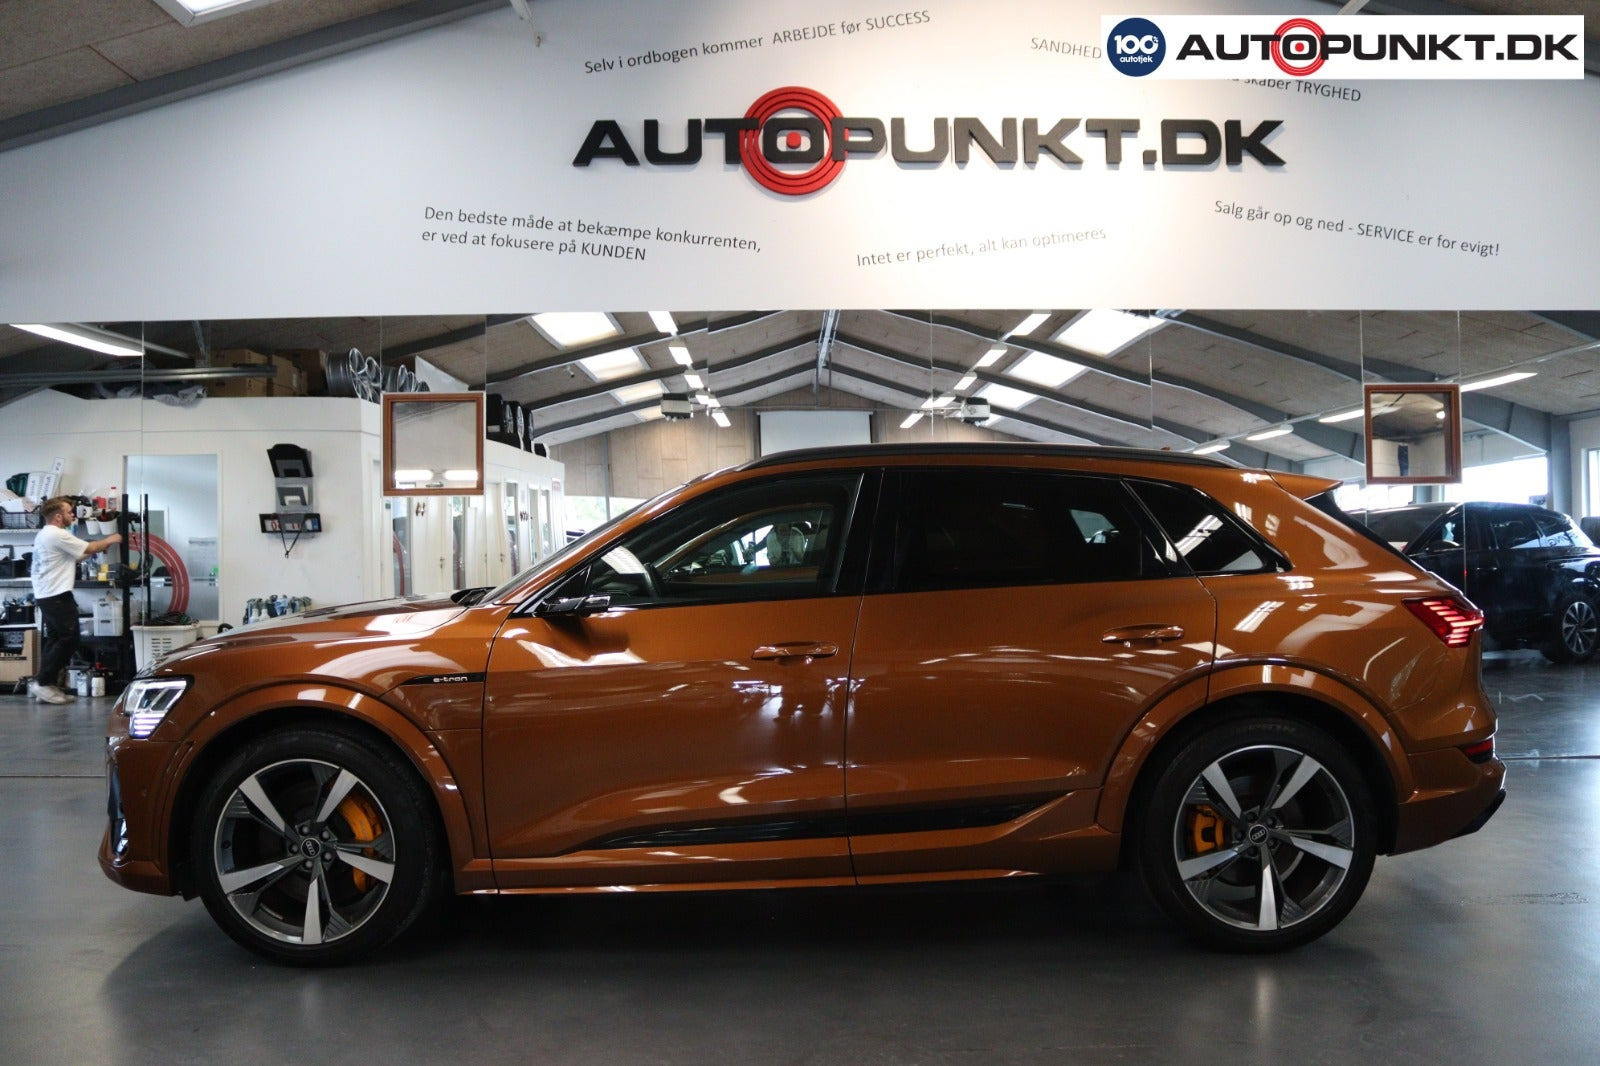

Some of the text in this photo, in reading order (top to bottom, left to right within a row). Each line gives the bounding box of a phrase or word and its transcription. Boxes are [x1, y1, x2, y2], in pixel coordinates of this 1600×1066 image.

[585, 10, 930, 73] Selv i ordbogen kommer ARBEJDE før SUCCESS
[1031, 37, 1102, 59] SANDHED
[1295, 80, 1361, 102] TRYGHED
[573, 118, 1286, 168] AUTOPUNKT.DK
[422, 231, 645, 261] er ved at fokusere på KUNDEN
[425, 207, 760, 253] Den bedste måde at bekæmpe konkurrenten,
[857, 229, 1106, 267] Intet er perfekt, alt kan optimeres
[1215, 201, 1243, 219] Salg
[1247, 206, 1270, 221] går
[1274, 213, 1291, 226] op
[1296, 217, 1313, 230] og
[1318, 220, 1344, 232] ned
[1357, 223, 1414, 243] SERVICE
[1418, 235, 1433, 246] er
[1437, 235, 1457, 249] for
[1461, 242, 1499, 257] evigt!
